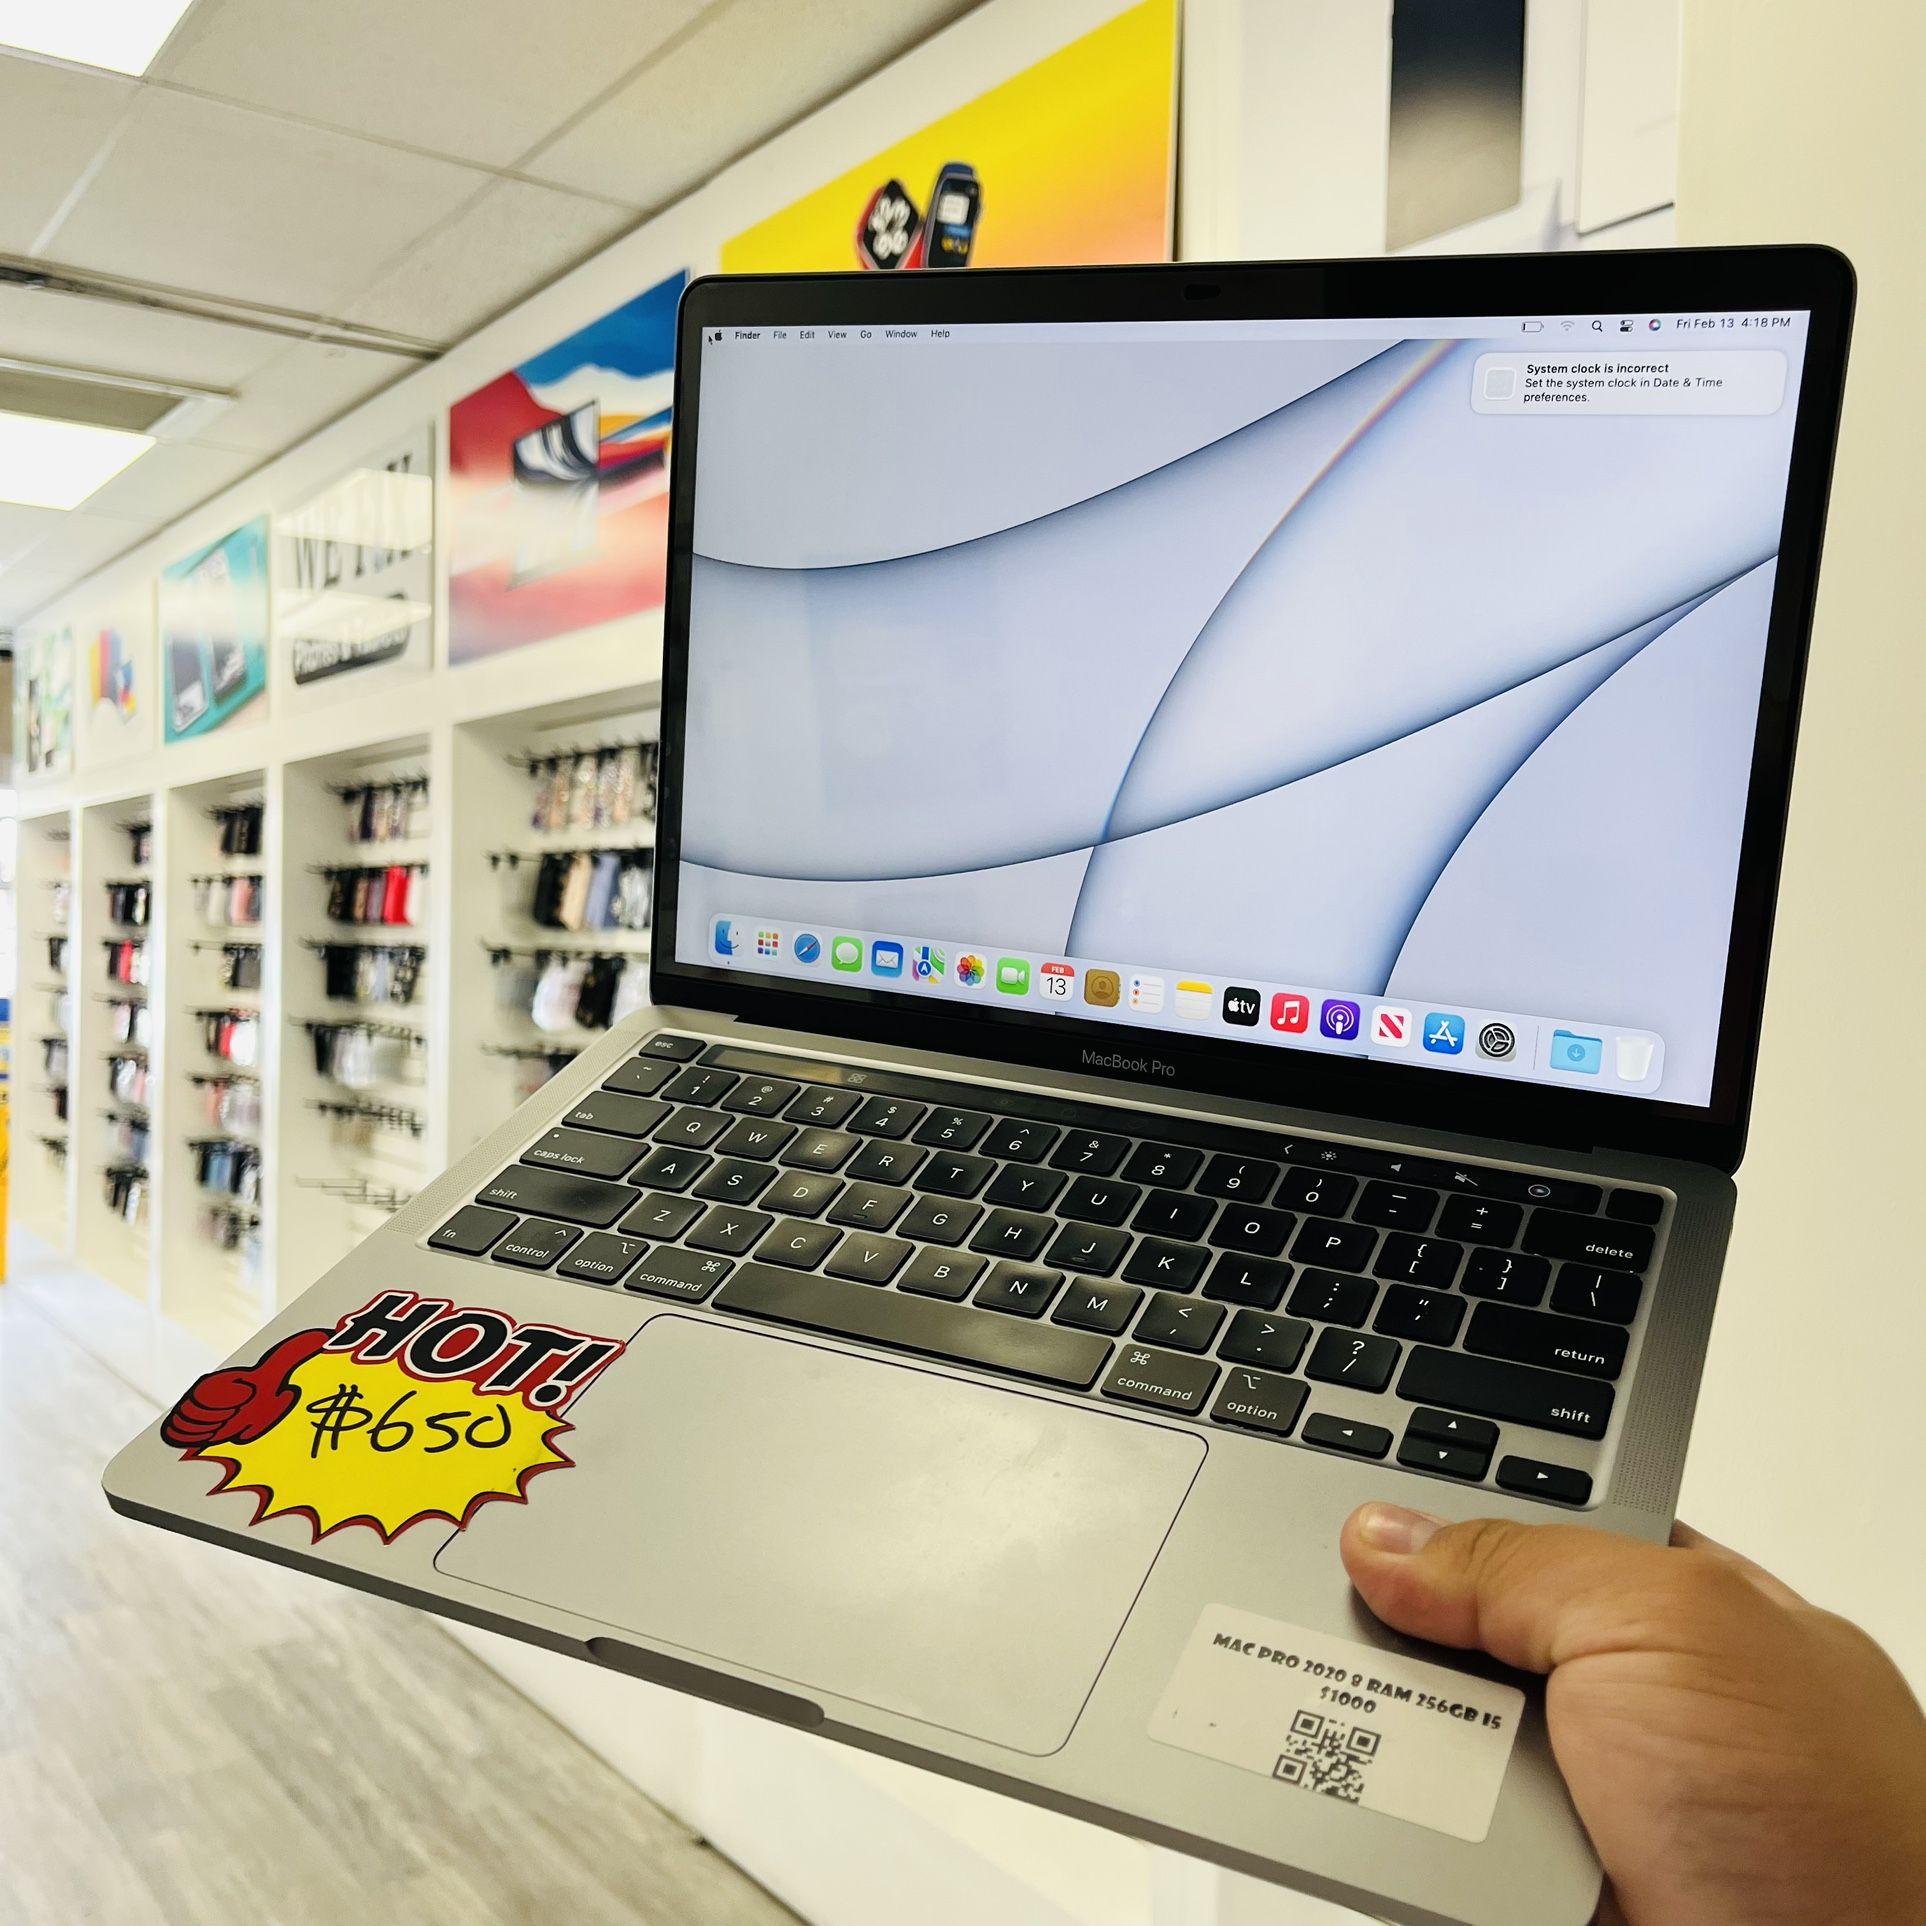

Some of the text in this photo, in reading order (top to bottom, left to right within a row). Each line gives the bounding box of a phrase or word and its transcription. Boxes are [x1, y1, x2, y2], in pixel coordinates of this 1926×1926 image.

[1676, 317, 1791, 329] Fri Feb 13 4:18 PM
[735, 329, 950, 340] Finder File Edit View Go Window Help
[1527, 363, 1669, 375] System clock is incorrect
[1525, 377, 1723, 390] Set the system clock in Date & Time
[1523, 392, 1590, 404] preferences.
[1051, 965, 1066, 974] FEB
[1045, 977, 1067, 996] 13
[1239, 999, 1255, 1015] tv
[654, 1041, 674, 1050] esc
[1081, 1048, 1176, 1077] MacBook Pro
[690, 1086, 701, 1095] 1
[748, 1096, 763, 1106] 2
[575, 1111, 594, 1121] tab
[810, 1106, 825, 1116] 3
[686, 1121, 701, 1133] Q
[875, 1117, 889, 1127] 4
[748, 1131, 768, 1144] W
[940, 1128, 955, 1139] 5
[812, 1143, 829, 1155] E
[1008, 1140, 1023, 1151] 6
[533, 1149, 585, 1165] caps lock
[878, 1155, 894, 1167] R
[1079, 1151, 1094, 1162] 7
[661, 1163, 676, 1174] A
[950, 1167, 964, 1179] T
[1151, 1164, 1166, 1176] 8
[727, 1174, 743, 1186] S
[1021, 1180, 1034, 1192] Y
[1226, 1177, 1241, 1189] 9
[489, 1187, 518, 1201] shift
[792, 1186, 809, 1198] D
[1305, 1191, 1319, 1203] 0
[861, 1199, 878, 1210] F
[1090, 1193, 1108, 1206] U
[652, 1209, 672, 1222] Z
[932, 1213, 949, 1225] G
[441, 1230, 457, 1239] fn
[719, 1222, 739, 1236] X
[1004, 1226, 1023, 1240] H
[790, 1236, 807, 1249] C
[1081, 1242, 1097, 1254] J
[1325, 1236, 1342, 1248] P
[505, 1243, 550, 1259] control
[864, 1250, 880, 1263] V
[1584, 1242, 1634, 1259] delete
[574, 1258, 615, 1274] option
[1157, 1256, 1175, 1270] K
[933, 1265, 951, 1278] B
[639, 1272, 702, 1293] command
[1240, 1271, 1252, 1286] L
[1009, 1280, 1029, 1295] N
[1086, 1296, 1109, 1311] M
[323, 1292, 619, 1407] HOT!
[1554, 1347, 1606, 1365] return
[1116, 1376, 1194, 1402] command
[1226, 1400, 1278, 1420] option
[1550, 1407, 1592, 1424] shift
[306, 1383, 511, 1459] $650
[1213, 1633, 1256, 1656] MAC
[1257, 1646, 1300, 1669] PRO
[1303, 1660, 1347, 1683] 2020
[1366, 1678, 1413, 1703] RAM
[1417, 1692, 1479, 1722] 256GB
[1320, 1687, 1377, 1714] $1000
